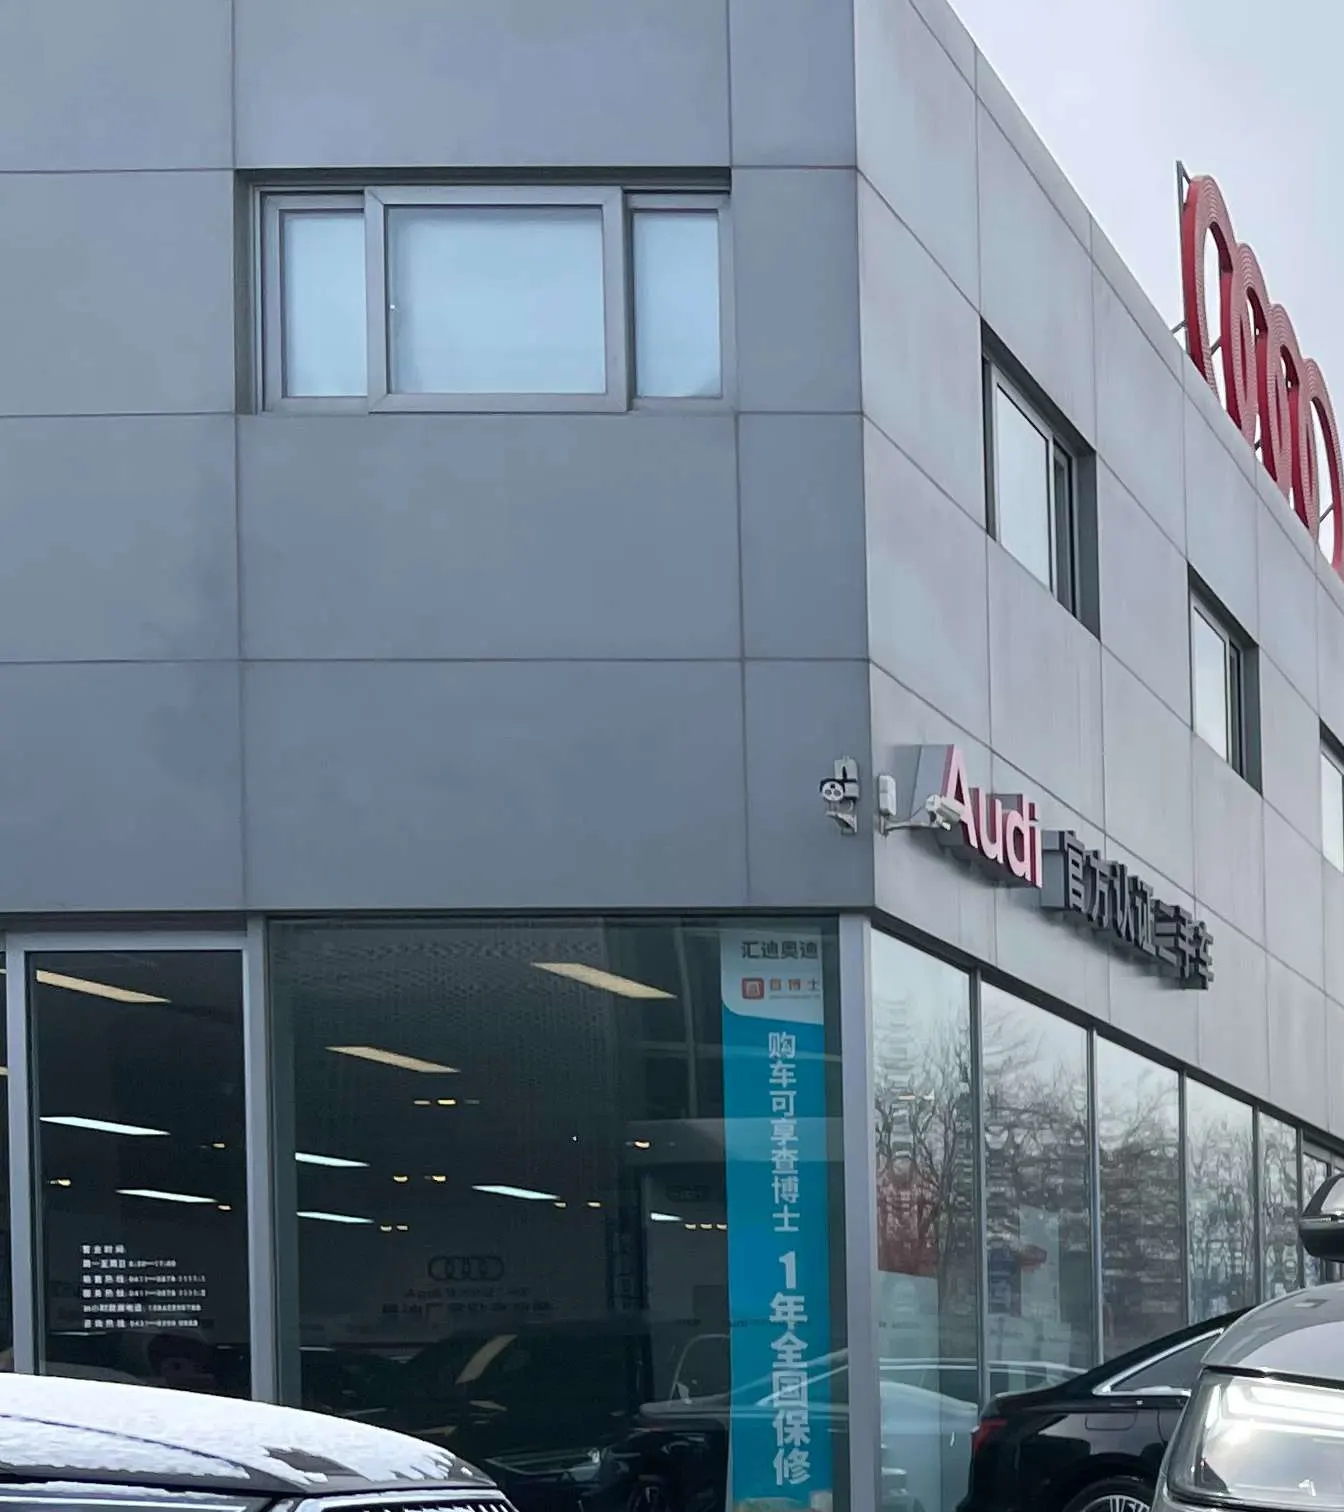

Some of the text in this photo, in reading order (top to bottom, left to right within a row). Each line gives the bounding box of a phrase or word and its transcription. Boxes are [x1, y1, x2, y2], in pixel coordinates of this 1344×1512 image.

[940, 744, 1042, 888] Audi
[741, 940, 819, 960] 汇迪奥迪
[768, 1031, 801, 1233] 购车可享查博士
[769, 1251, 811, 1486] 1年全国保修
